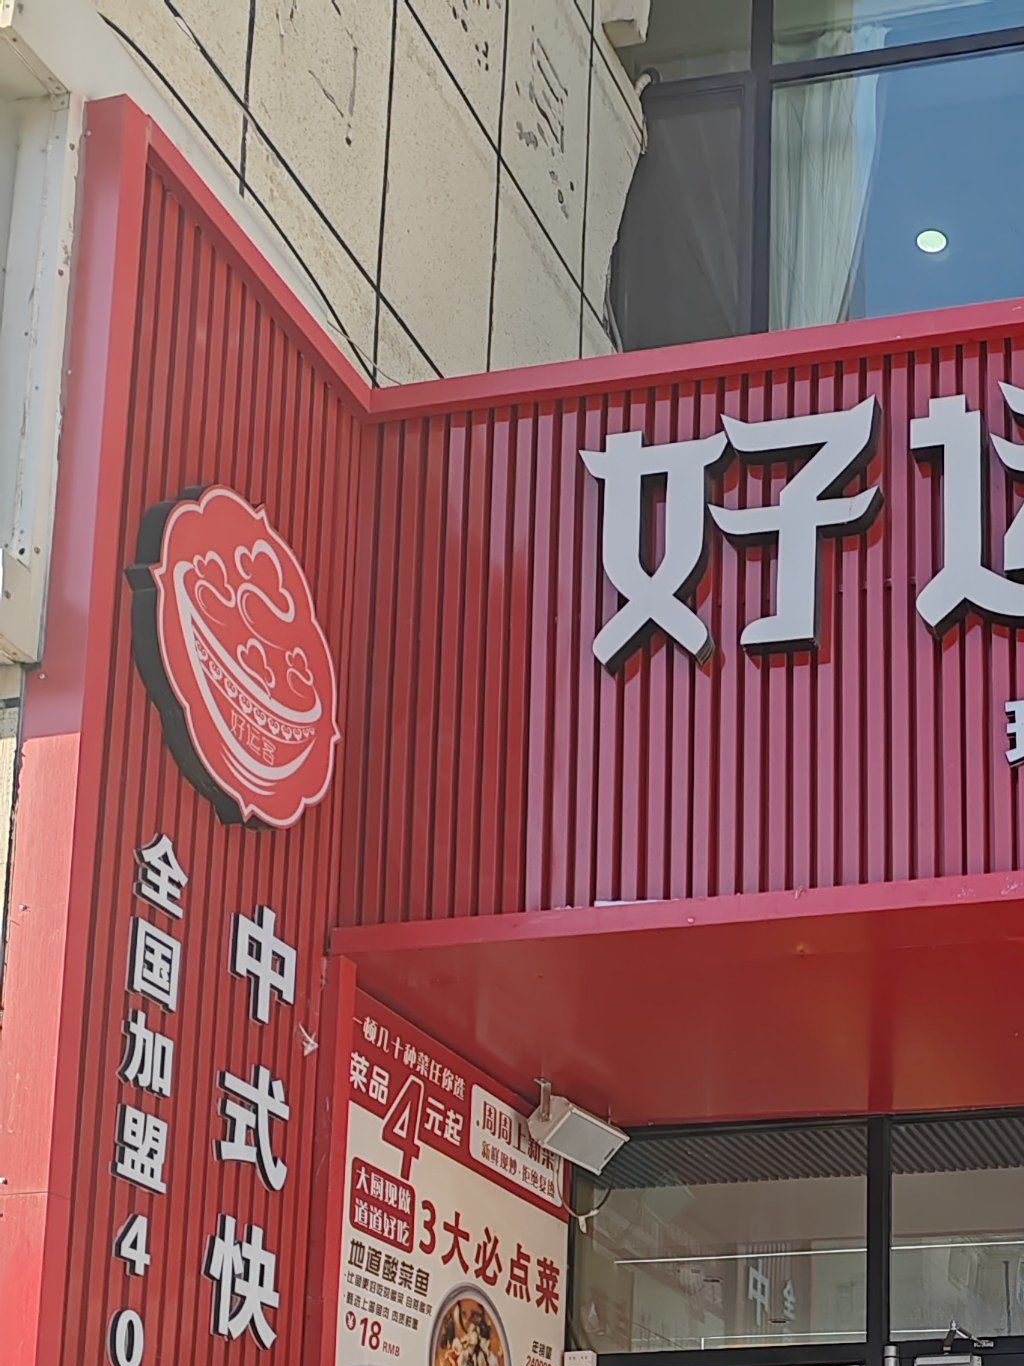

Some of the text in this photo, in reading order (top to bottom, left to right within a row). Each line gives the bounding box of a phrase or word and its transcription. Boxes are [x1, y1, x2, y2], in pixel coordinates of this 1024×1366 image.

[229, 709, 277, 767] 好运客
[352, 1015, 467, 1102] 一顿几十种菜任你选
[355, 1166, 411, 1215] 大厨现做
[353, 1198, 411, 1246] 道道好吃
[347, 1237, 430, 1297] 地道酸菜鱼
[418, 1198, 561, 1315] 3大必点菜
[382, 1340, 400, 1357] RMB
